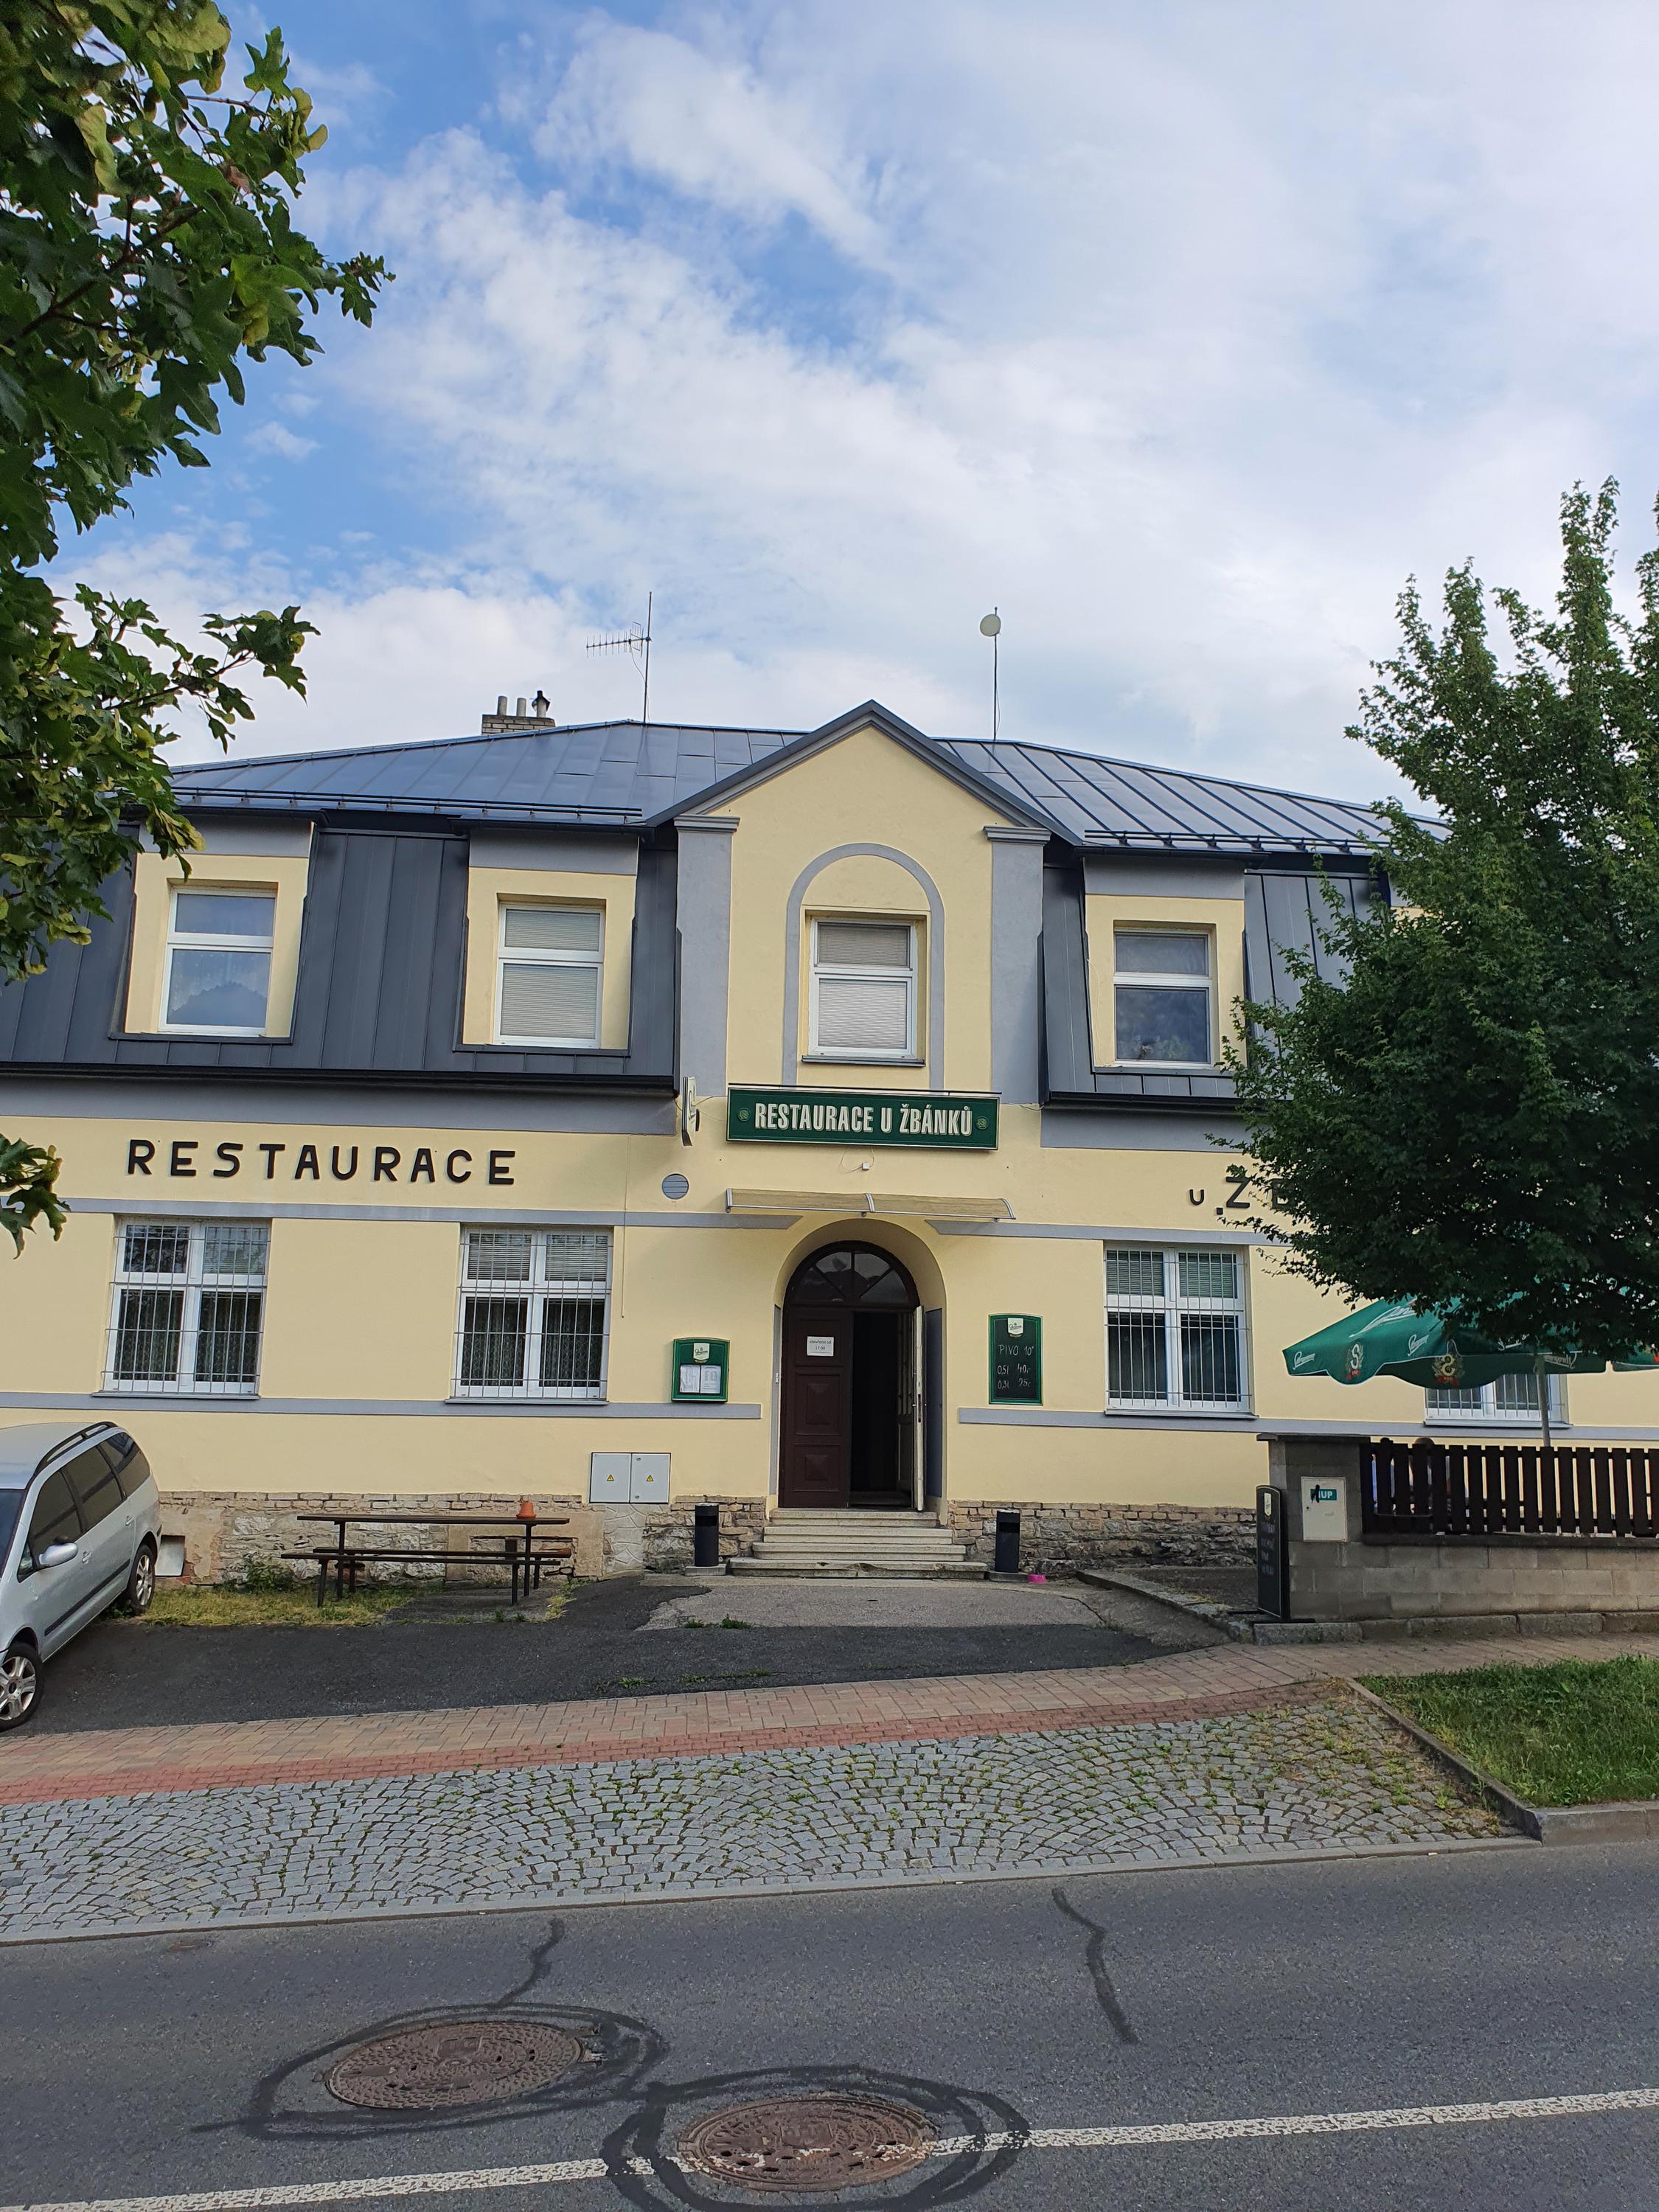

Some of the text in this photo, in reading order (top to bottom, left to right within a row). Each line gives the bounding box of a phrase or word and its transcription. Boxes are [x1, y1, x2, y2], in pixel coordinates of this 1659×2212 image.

[754, 1103, 973, 1136] RESTAURACE U ŽBÁNKŮ
[127, 1138, 515, 1186] RESTAURACE
[998, 1345, 1018, 1356] PIVO
